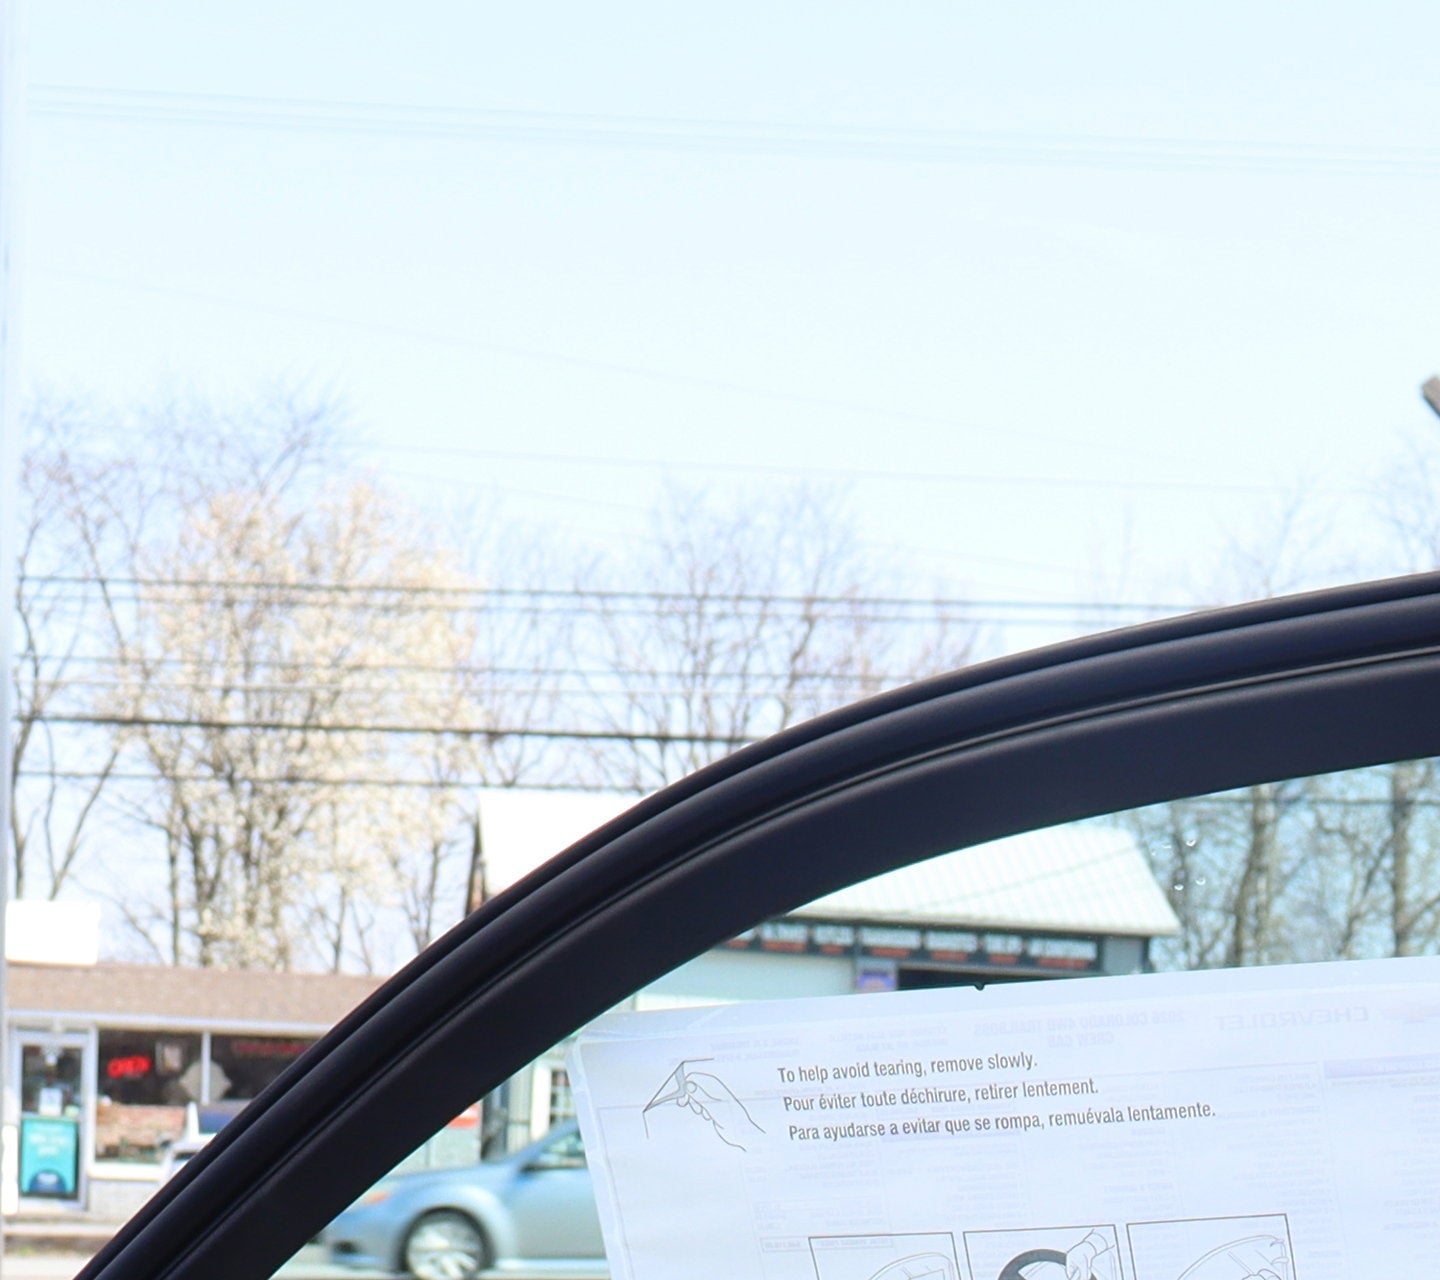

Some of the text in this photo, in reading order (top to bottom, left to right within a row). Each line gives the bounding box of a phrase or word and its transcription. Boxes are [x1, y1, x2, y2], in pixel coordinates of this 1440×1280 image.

[778, 1052, 1037, 1083] To help avoid tearing, remove slowly.
[784, 1079, 1098, 1111] Pour éviter toute déchirure, retirer lentement.
[789, 1103, 1215, 1141] Para ayudarse a evitar que se rompa, remuévala lentamente.
